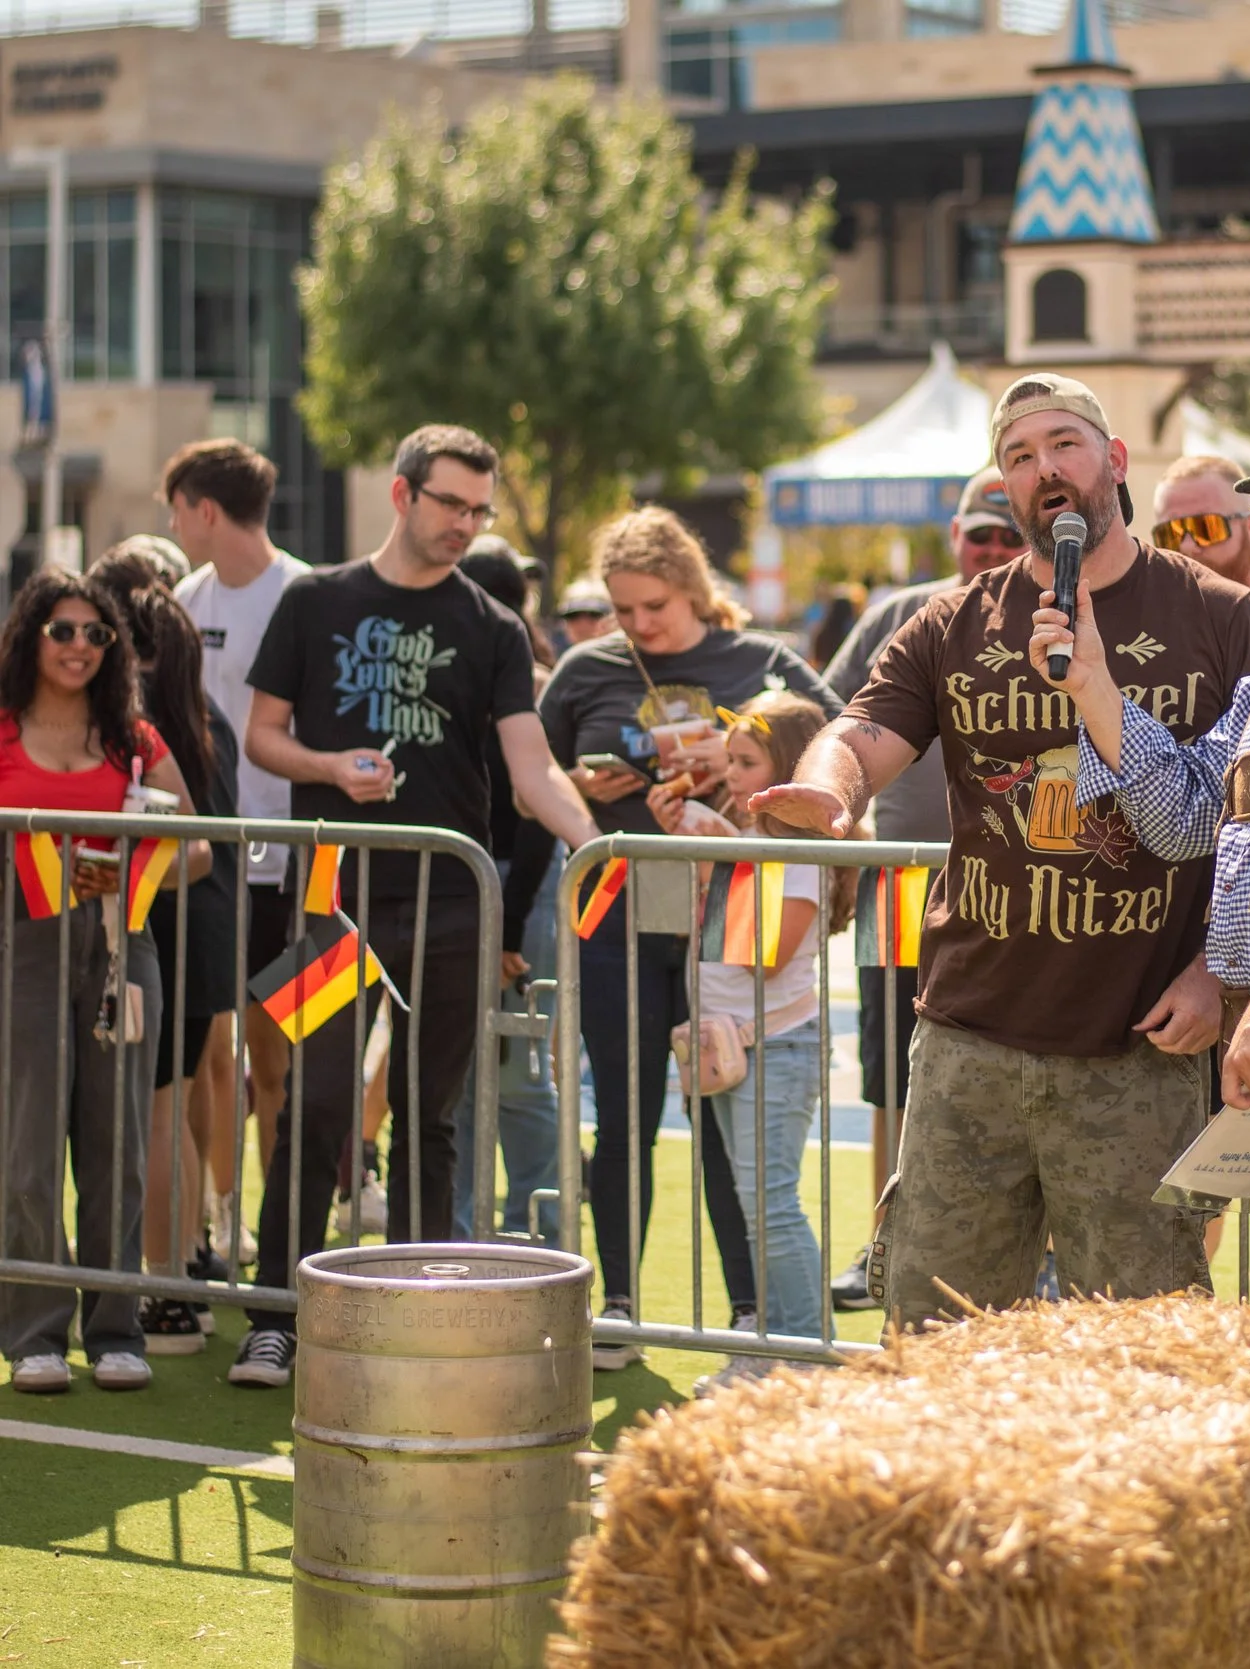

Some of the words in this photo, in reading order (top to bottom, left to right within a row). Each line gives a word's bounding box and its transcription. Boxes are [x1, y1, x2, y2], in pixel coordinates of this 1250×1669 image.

[356, 616, 435, 665] God
[945, 671, 1205, 736] Schnel
[958, 854, 1011, 941] My
[1025, 863, 1179, 943] Nitzel
[403, 1306, 507, 1328] BREWERY
